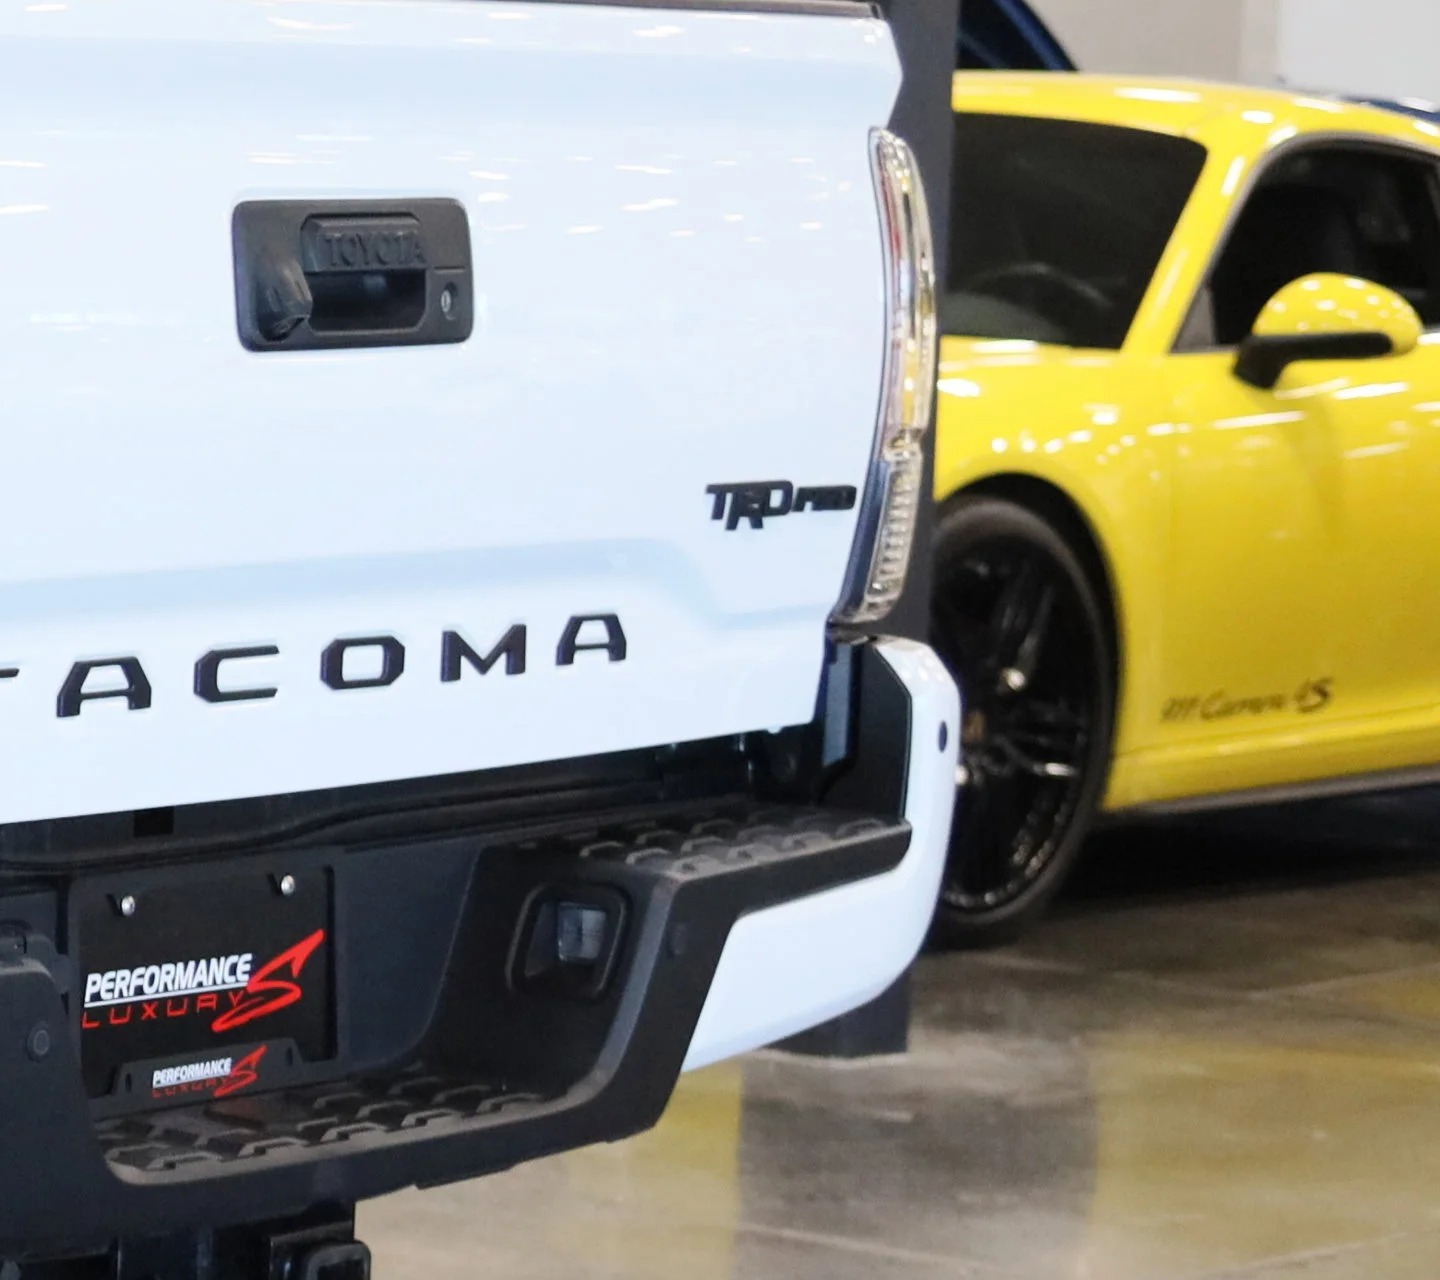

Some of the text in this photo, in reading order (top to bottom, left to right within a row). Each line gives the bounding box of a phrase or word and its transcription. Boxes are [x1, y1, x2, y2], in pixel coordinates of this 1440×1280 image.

[323, 231, 428, 267] TOYOTA
[706, 480, 793, 531] TRD
[84, 952, 254, 1004] PERFORMANCE
[81, 990, 244, 1029] LUXURY
[152, 1057, 233, 1088] PERFORMANCE
